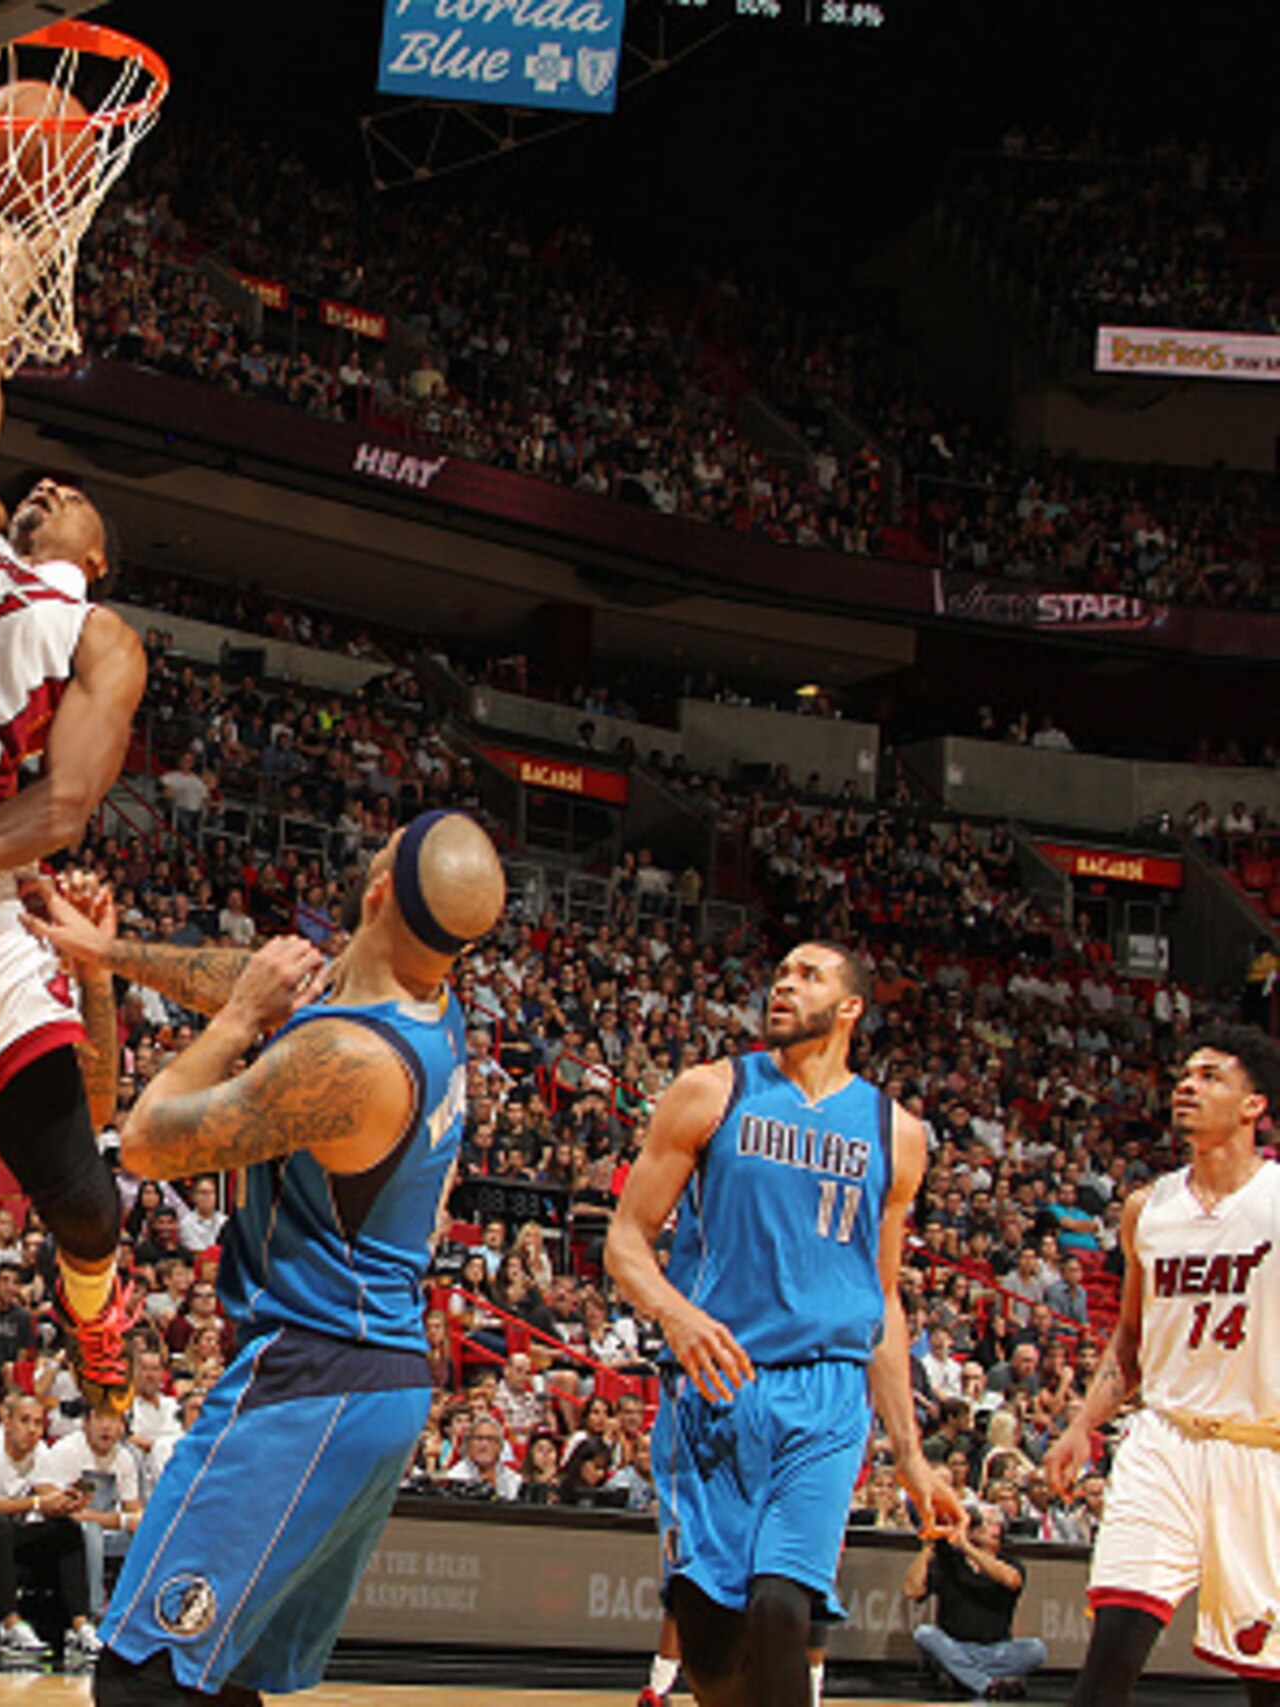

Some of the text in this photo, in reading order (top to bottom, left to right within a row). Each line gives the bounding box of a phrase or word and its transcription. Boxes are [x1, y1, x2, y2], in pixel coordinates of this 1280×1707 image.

[388, 28, 511, 82] Blue
[353, 443, 448, 488] HEAT
[738, 1112, 870, 1180] DALLAS
[816, 1180, 862, 1243] 11
[1154, 1241, 1272, 1297] HEAT
[1188, 1302, 1247, 1349] 14
[588, 1573, 663, 1622] BAC
